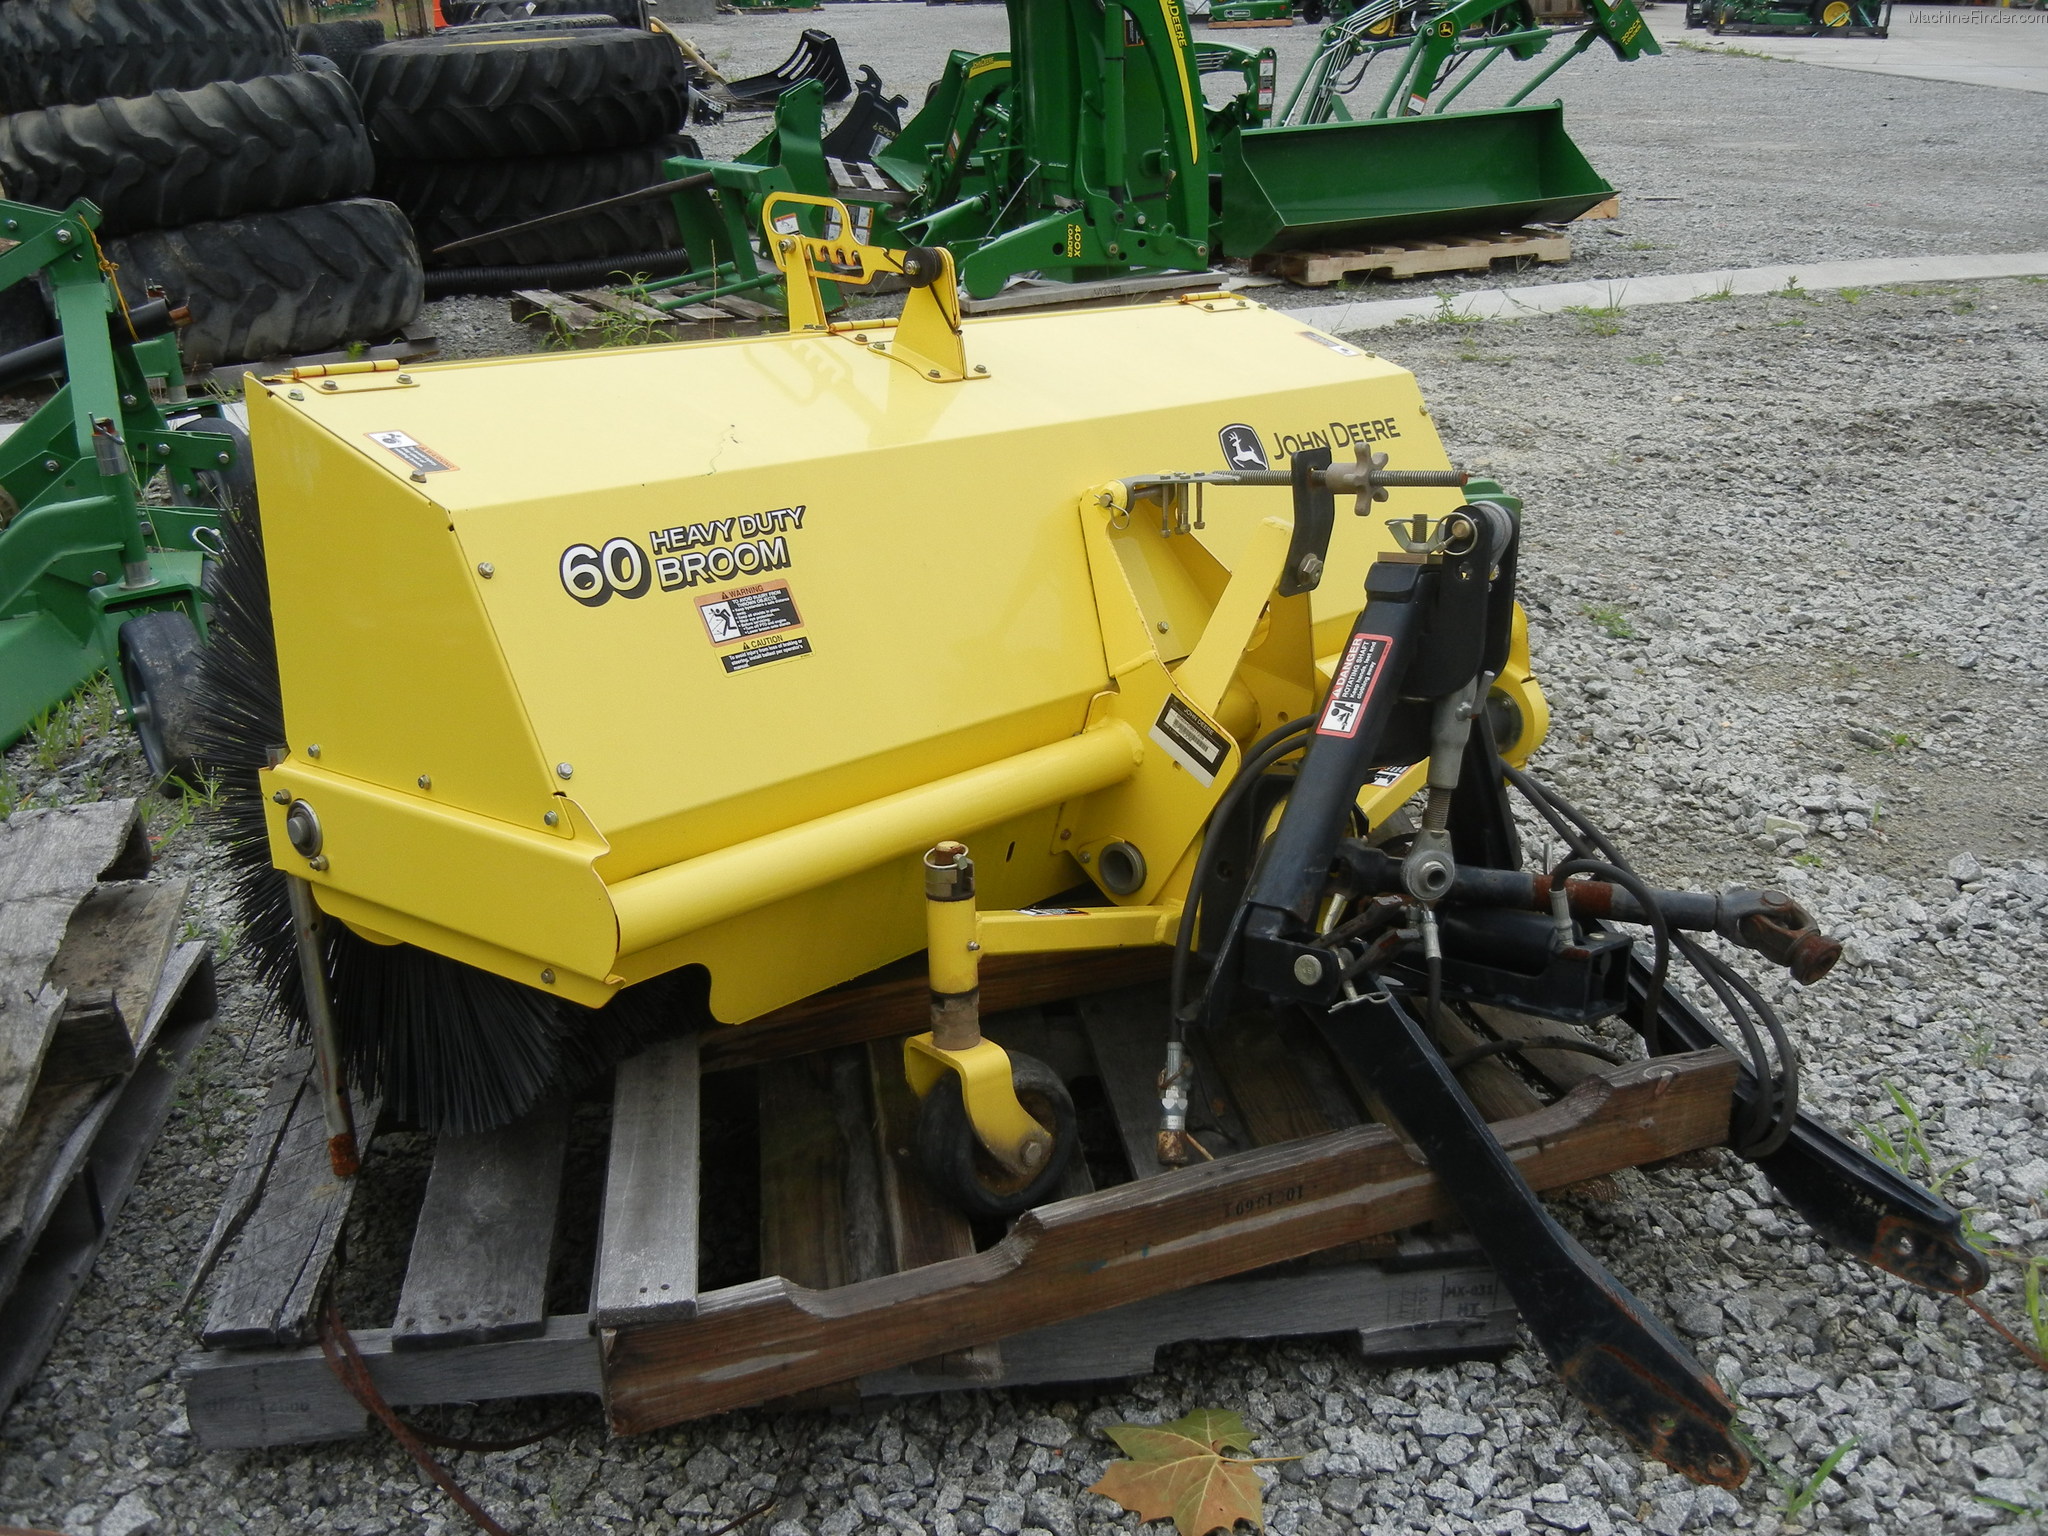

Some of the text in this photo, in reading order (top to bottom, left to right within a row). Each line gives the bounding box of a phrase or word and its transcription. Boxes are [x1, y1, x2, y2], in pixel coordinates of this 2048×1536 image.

[1170, 5, 1187, 47] DEERE
[1273, 417, 1401, 460] JOHN DEERE
[649, 505, 806, 554] HEAVY DUTY
[559, 537, 652, 607] 60
[655, 536, 792, 592] BROOM
[729, 585, 763, 598] WARNING
[751, 635, 783, 648] CAUTION
[1337, 638, 1363, 686] DANGER
[1342, 641, 1369, 698] ROTATING SHAFT
[1350, 683, 1359, 698] Keep
[1364, 652, 1372, 664] feet
[1369, 641, 1377, 652] and
[1357, 661, 1377, 699] clothing away
[1184, 708, 1197, 721] JOHN
[1197, 718, 1214, 736] DEERE
